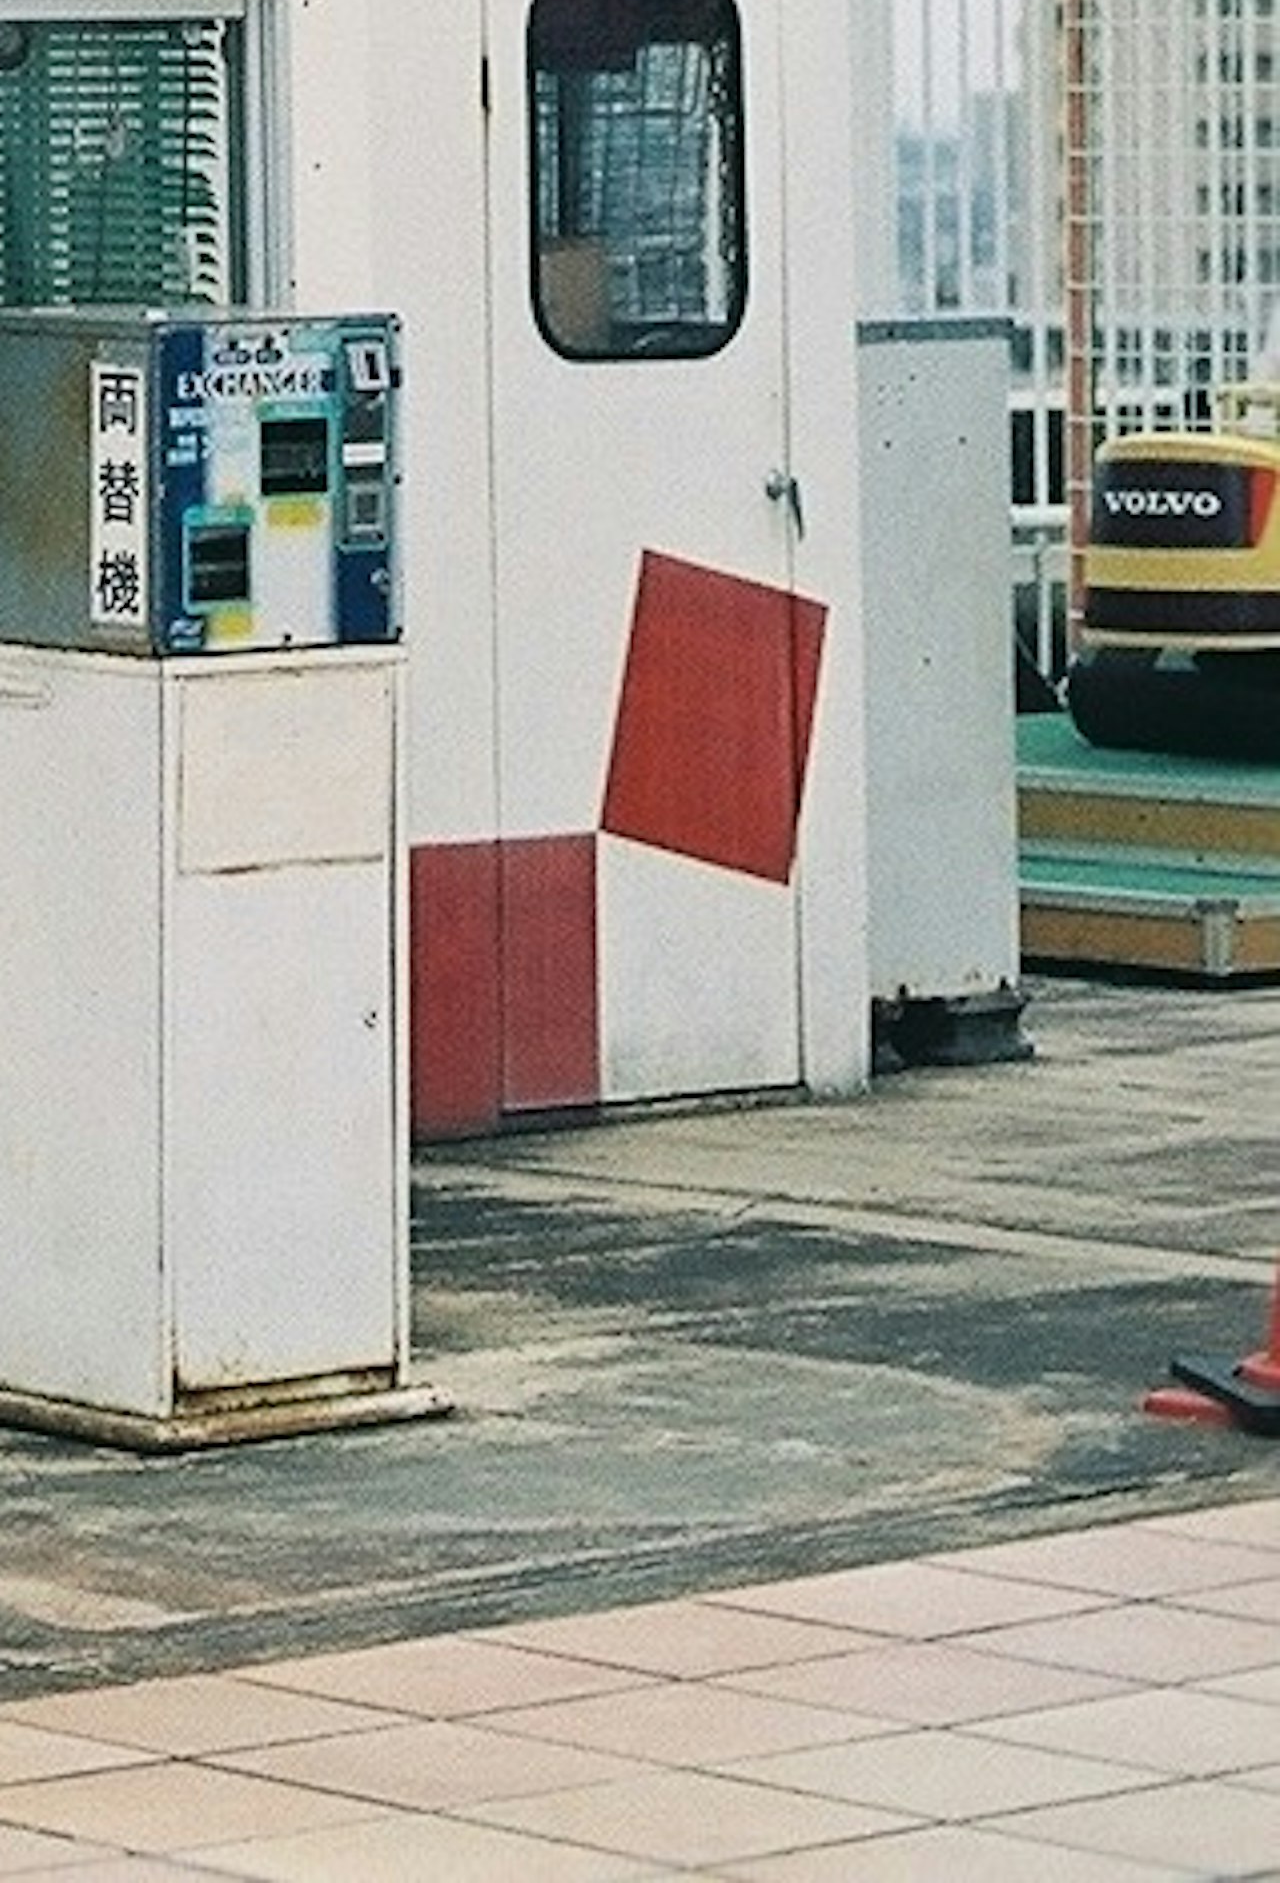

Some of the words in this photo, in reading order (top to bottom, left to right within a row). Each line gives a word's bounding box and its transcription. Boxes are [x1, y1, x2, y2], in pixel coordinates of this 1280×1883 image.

[98, 372, 139, 615] 両替機
[1103, 490, 1222, 517] VOLVO
